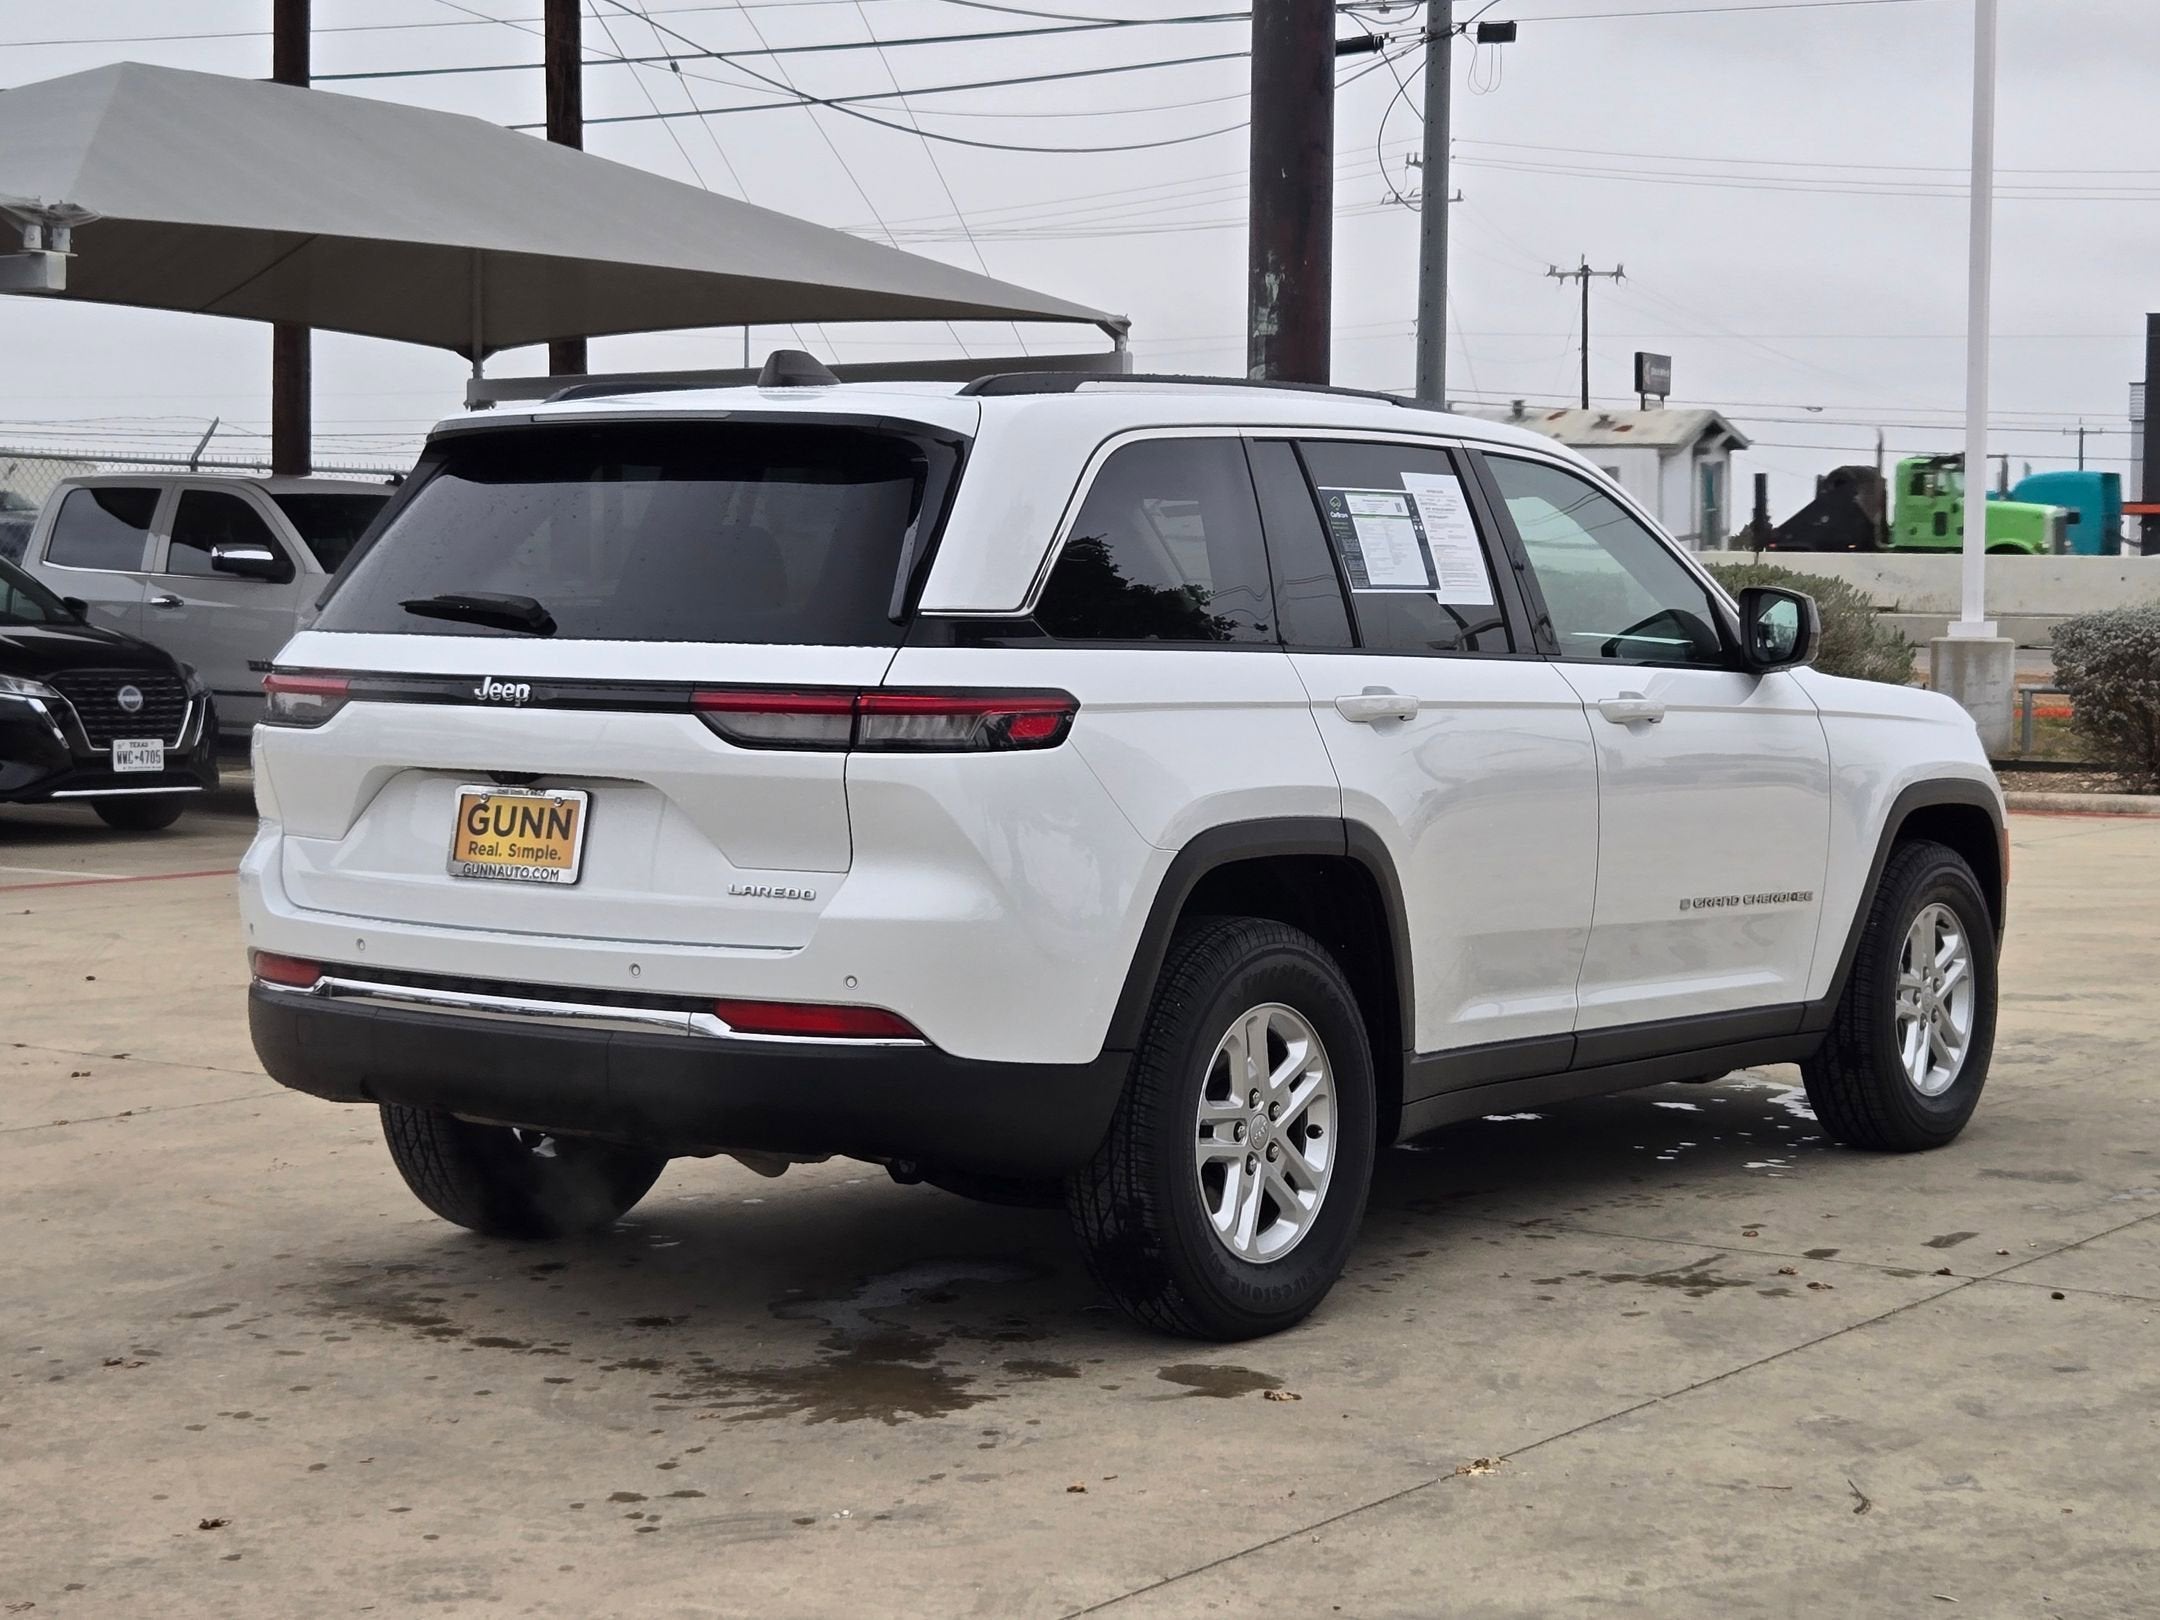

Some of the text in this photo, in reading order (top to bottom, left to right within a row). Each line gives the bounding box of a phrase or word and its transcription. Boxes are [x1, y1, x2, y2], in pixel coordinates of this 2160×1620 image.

[473, 676, 530, 706] Jeep
[467, 803, 573, 840] GUNN
[467, 840, 503, 857] Real.
[463, 862, 560, 882] GUNNAUTO.COM
[728, 883, 817, 901] LAREDO
[1692, 890, 1814, 909] GRAND CHEROKEE
